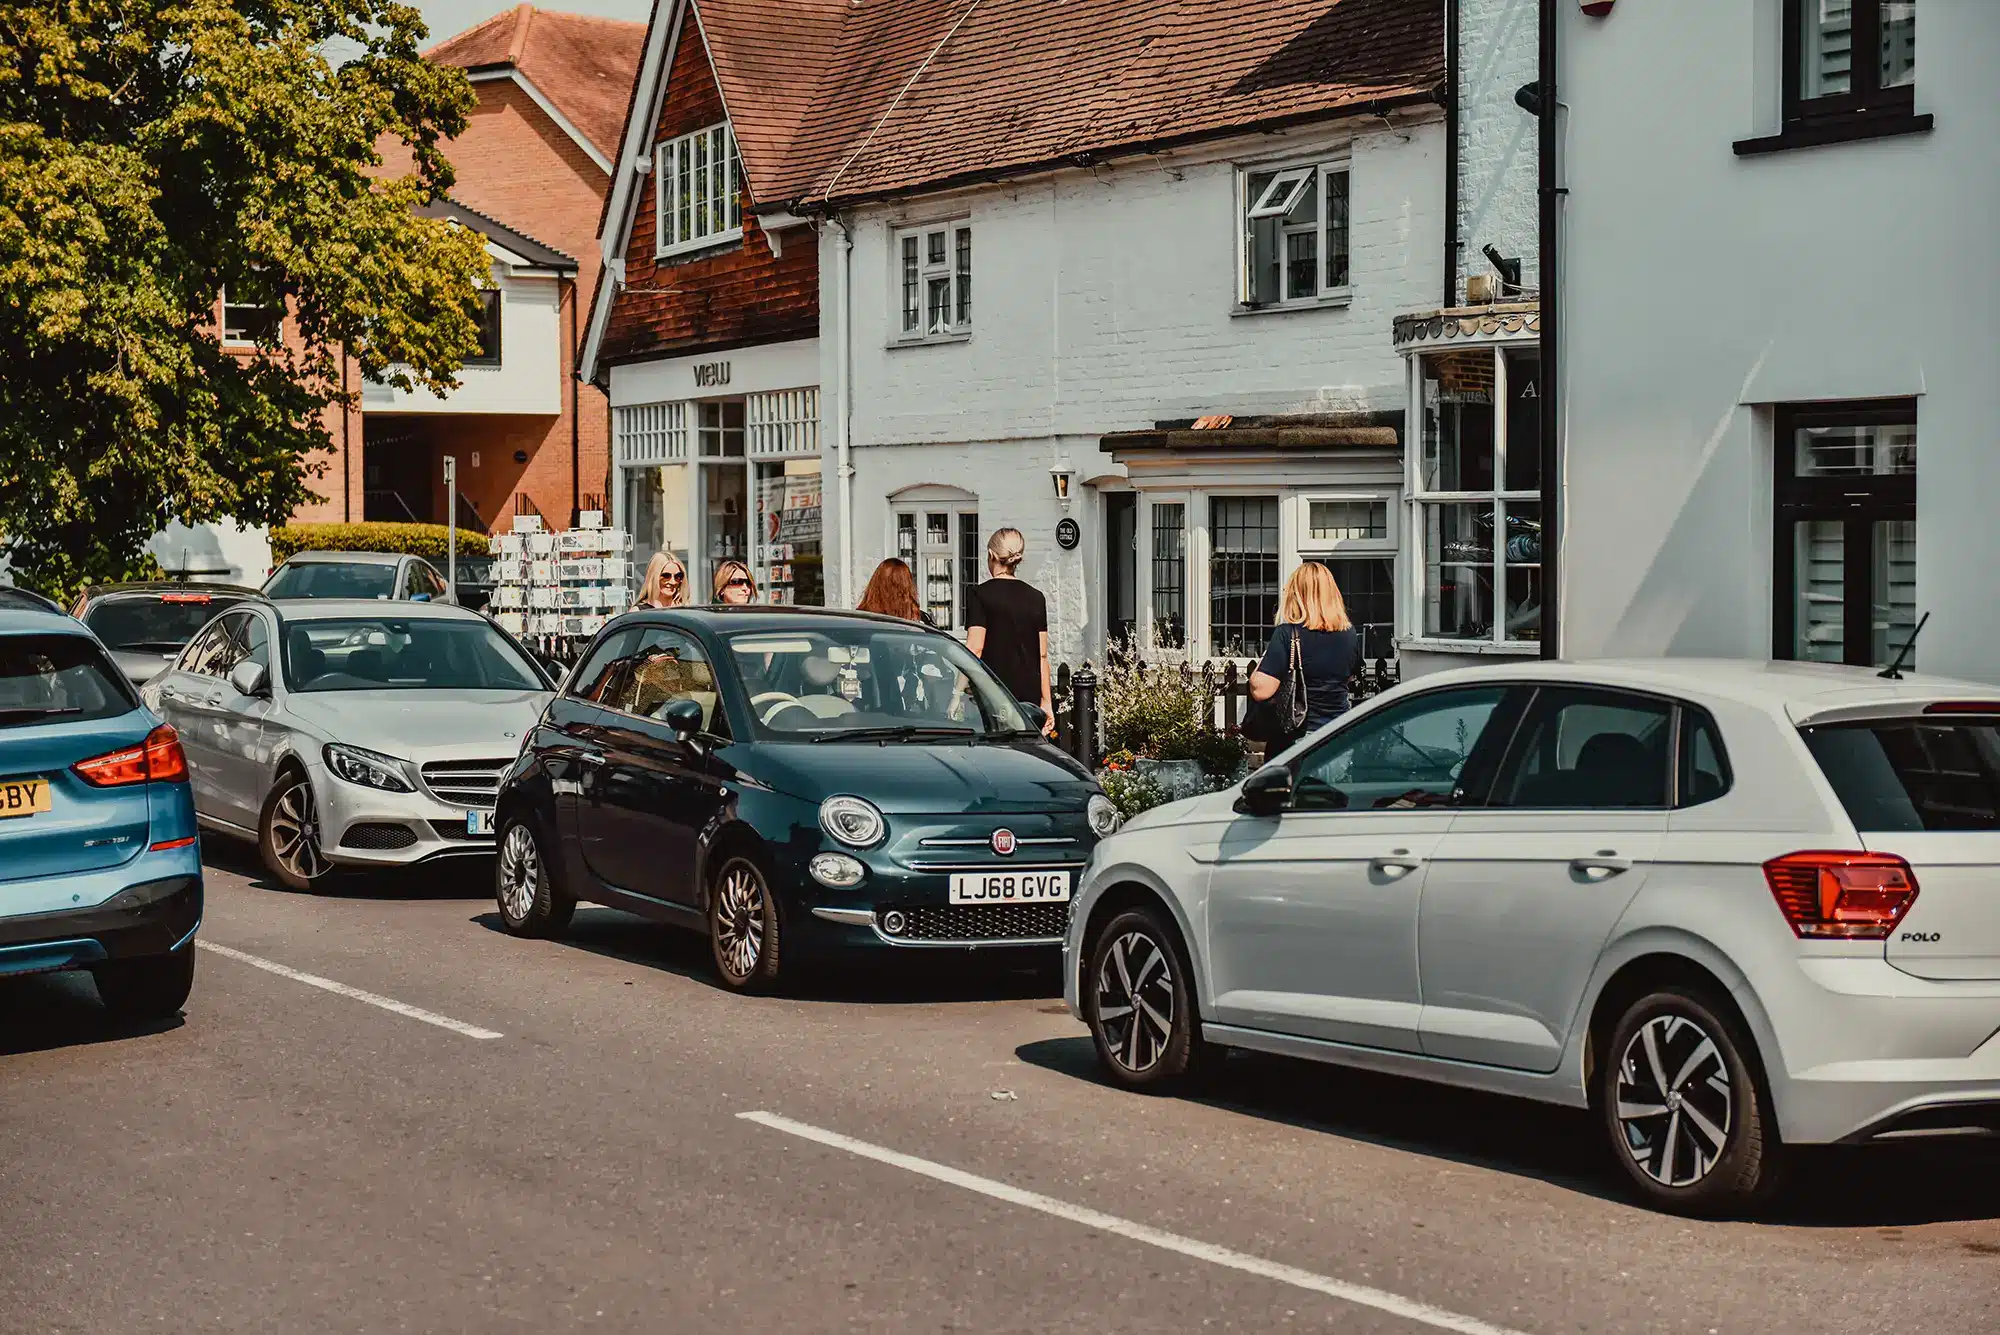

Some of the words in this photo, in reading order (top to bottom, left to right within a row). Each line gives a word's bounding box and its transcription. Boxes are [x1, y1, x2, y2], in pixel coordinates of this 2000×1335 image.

[693, 361, 731, 387] view
[0, 783, 38, 811] BY
[998, 836, 1011, 848] FIAT
[959, 877, 1015, 899] LJ68
[1022, 876, 1061, 897] GVG
[1901, 932, 1940, 942] POLO
